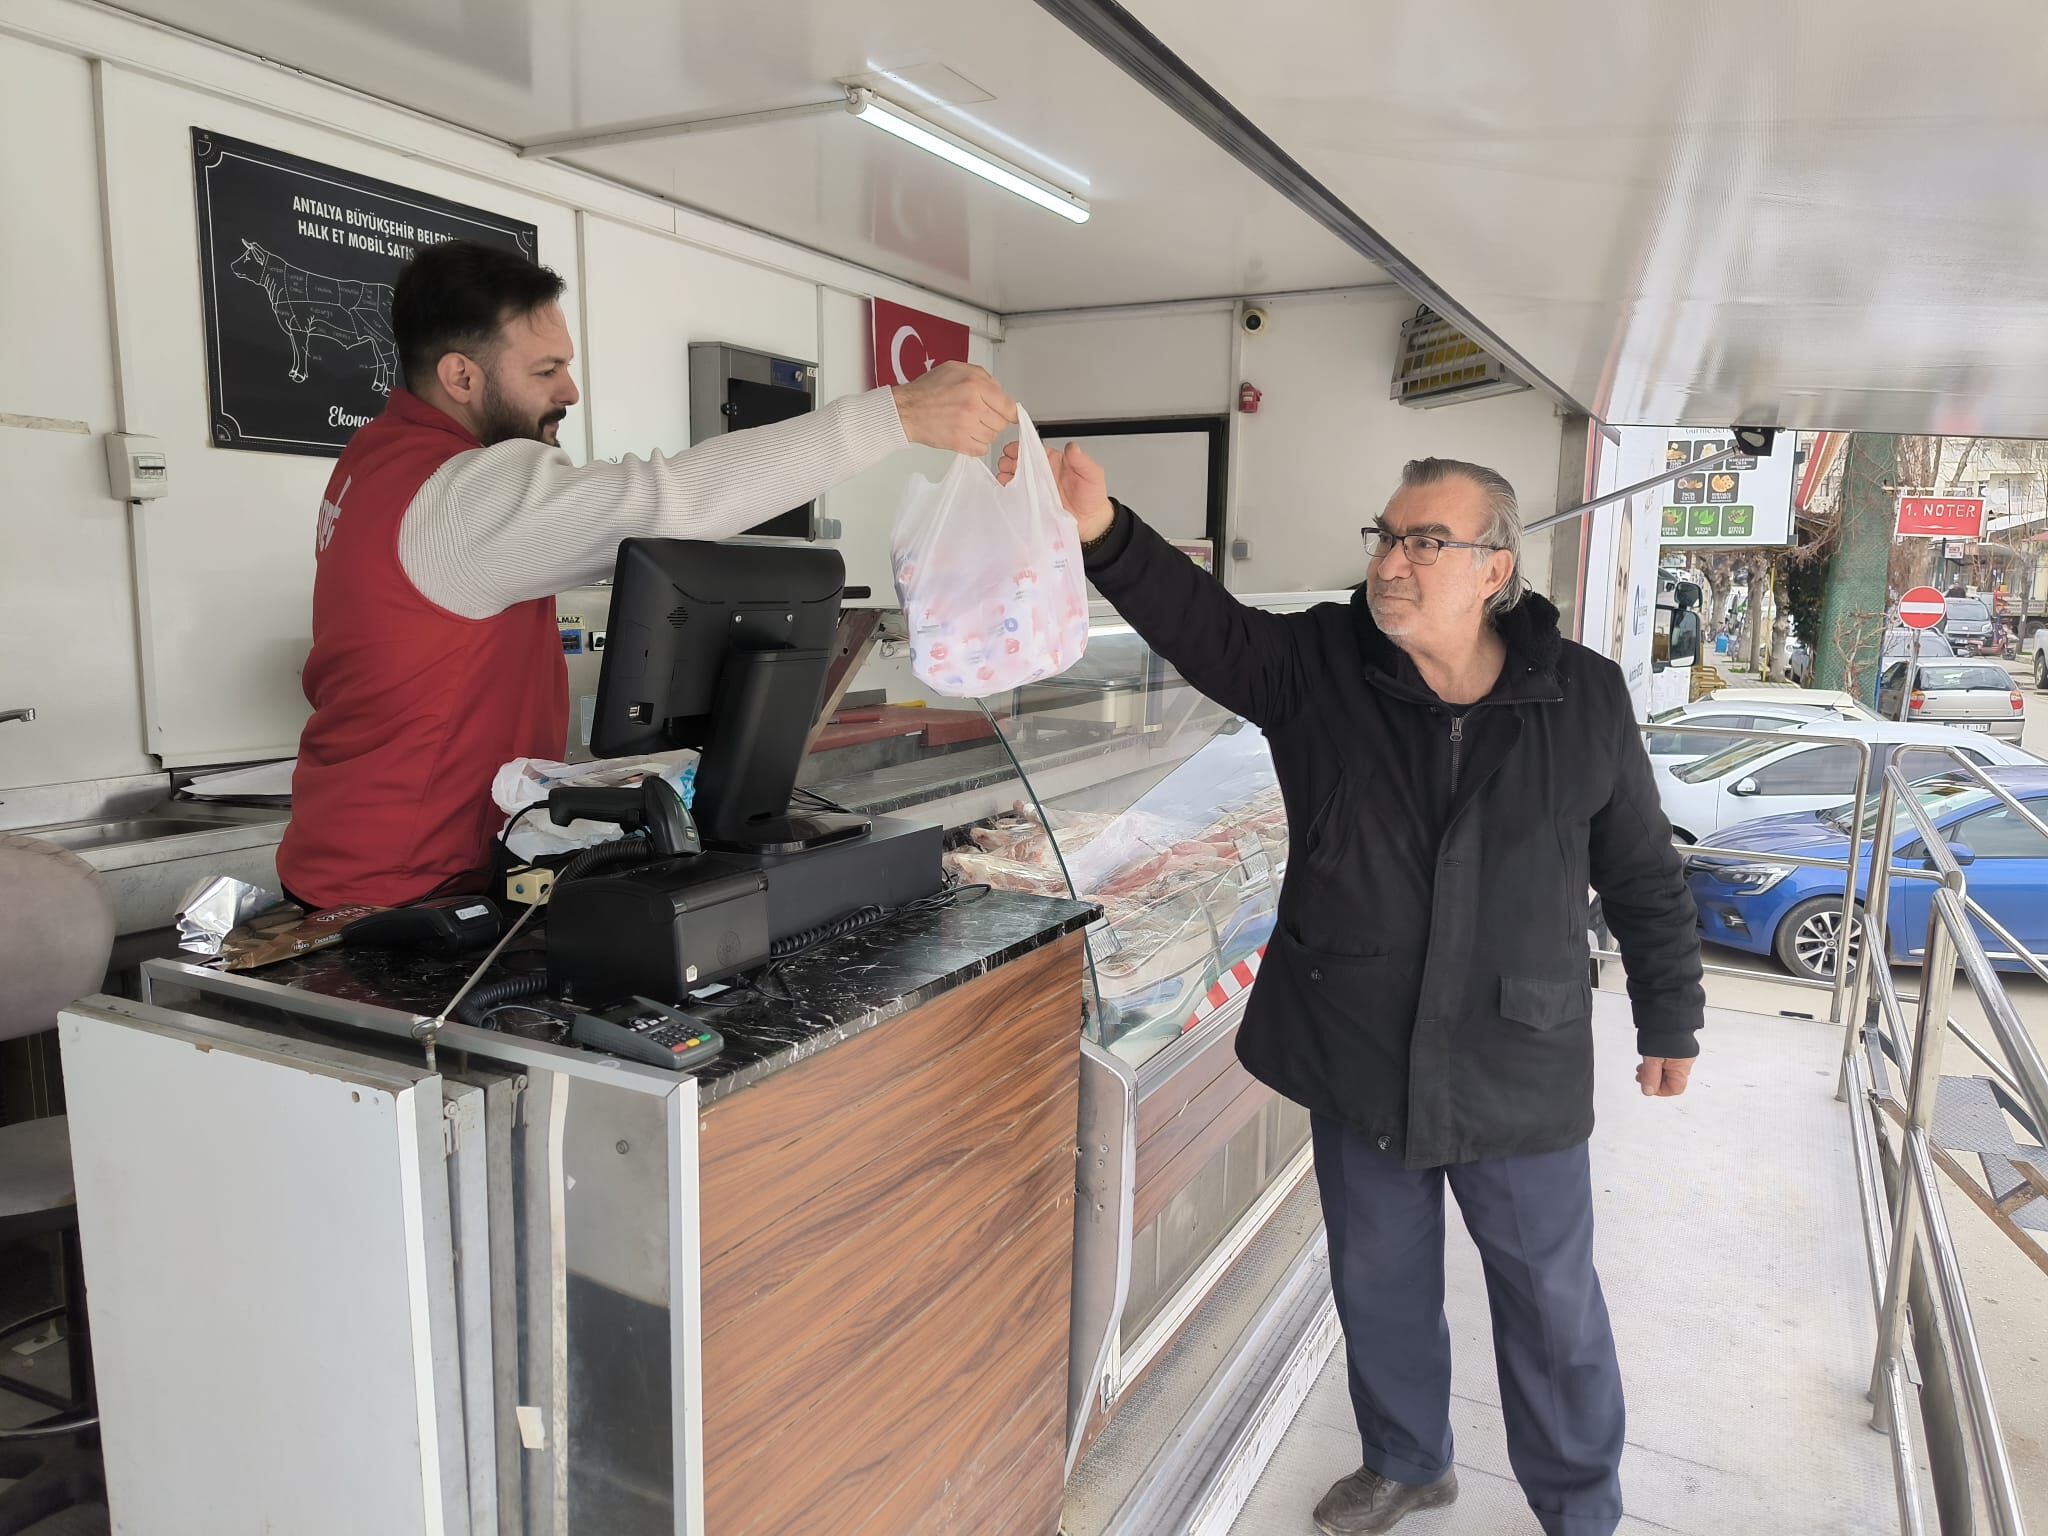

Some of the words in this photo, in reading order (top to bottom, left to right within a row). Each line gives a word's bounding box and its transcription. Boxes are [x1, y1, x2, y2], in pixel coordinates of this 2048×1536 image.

[292, 195, 343, 222] ANTALYA
[346, 207, 415, 240] BÜYÜKŞEHİR
[298, 219, 329, 241] HALK
[332, 227, 345, 245] ET
[348, 234, 385, 255] MOBİL
[328, 405, 374, 428] Ekono
[1905, 503, 1917, 517] 1.
[1923, 503, 1976, 518] NOTER
